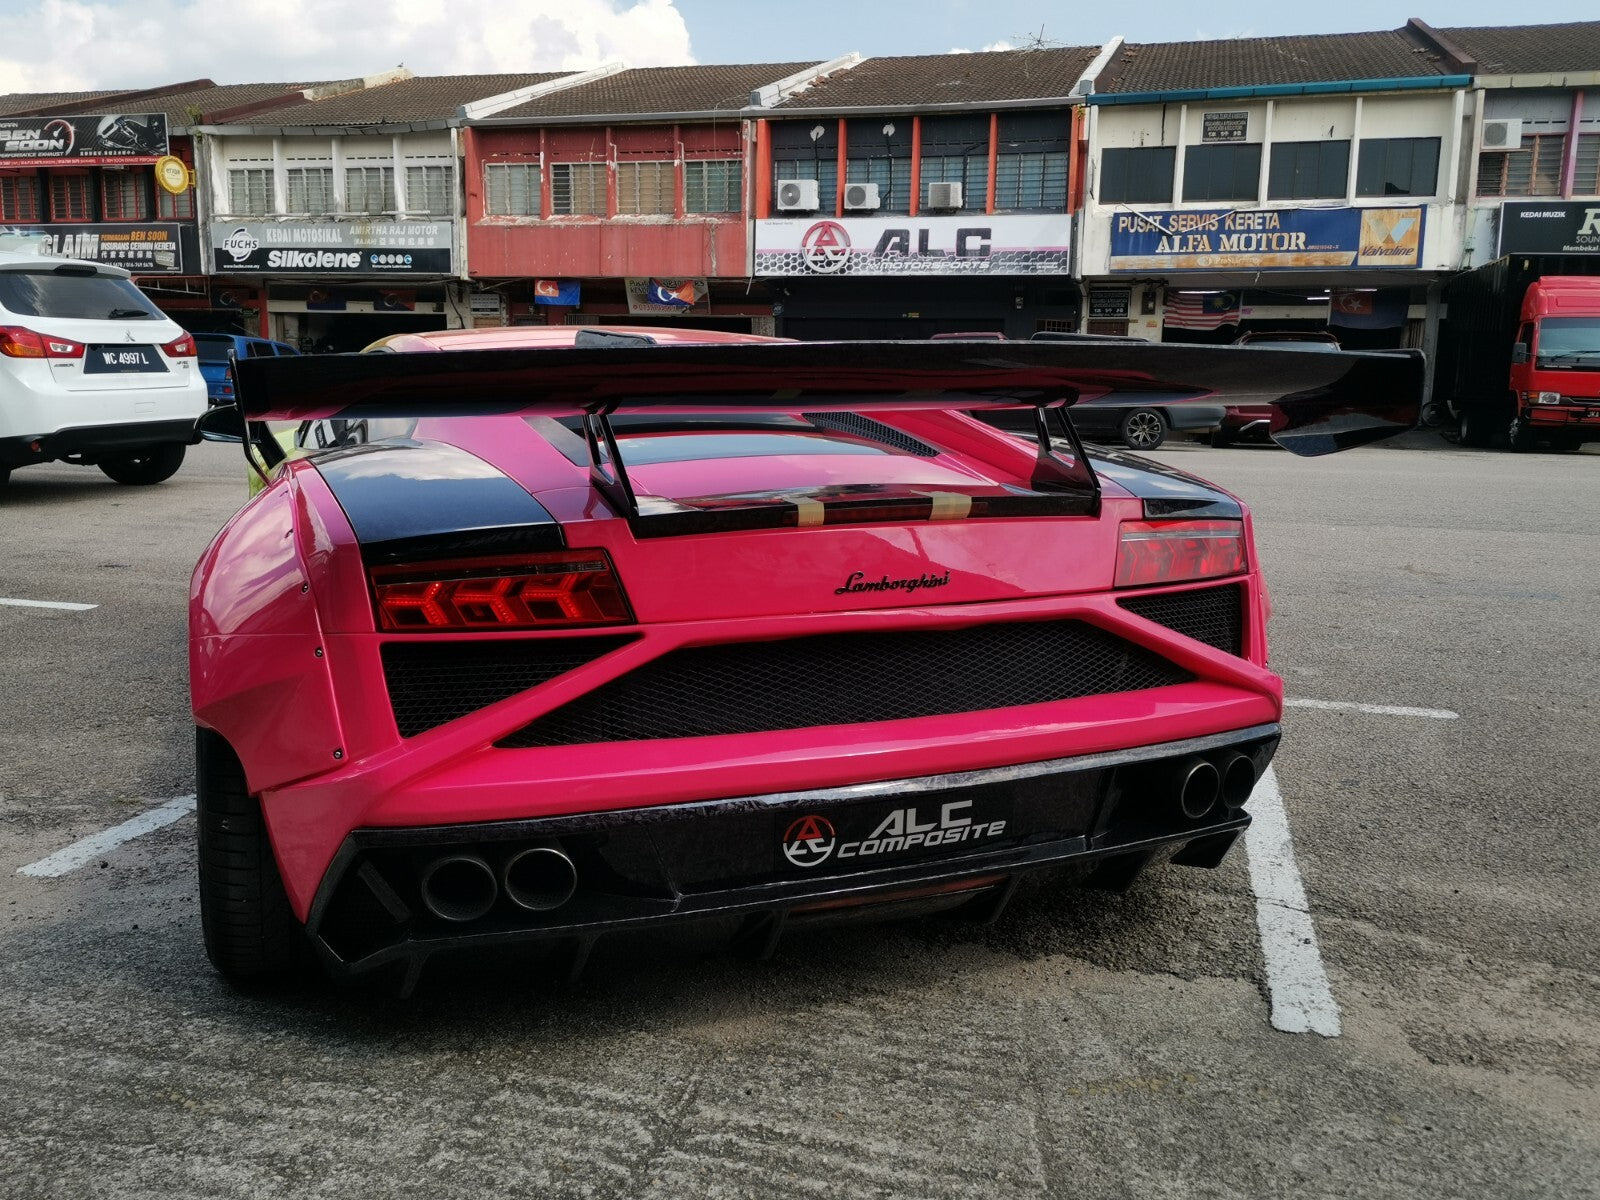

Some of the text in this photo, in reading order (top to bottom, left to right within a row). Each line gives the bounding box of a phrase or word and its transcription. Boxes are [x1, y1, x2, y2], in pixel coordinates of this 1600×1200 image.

[0, 129, 41, 140] BEN
[5, 139, 64, 151] SOON
[1118, 212, 1280, 233] PUSAT SERVIS KERETA
[130, 231, 146, 240] BEN
[148, 231, 168, 240] SOON
[266, 228, 342, 243] KEDAI MOTOSIKAL
[349, 225, 438, 235] AMIRTHA RAJ MOTOR
[41, 234, 99, 259] CLAIM
[154, 242, 176, 250] KERETA
[224, 240, 258, 248] FUCHS
[873, 228, 991, 258] ALC
[1155, 232, 1306, 253] ALFA MOTOR
[1362, 246, 1414, 256] Valvoline
[267, 250, 361, 268] Silkolene
[881, 261, 990, 270] MOTORSPORTS
[102, 352, 149, 365] WC 4997 L
[834, 570, 950, 595] Lamborghini
[868, 800, 972, 839] ALC
